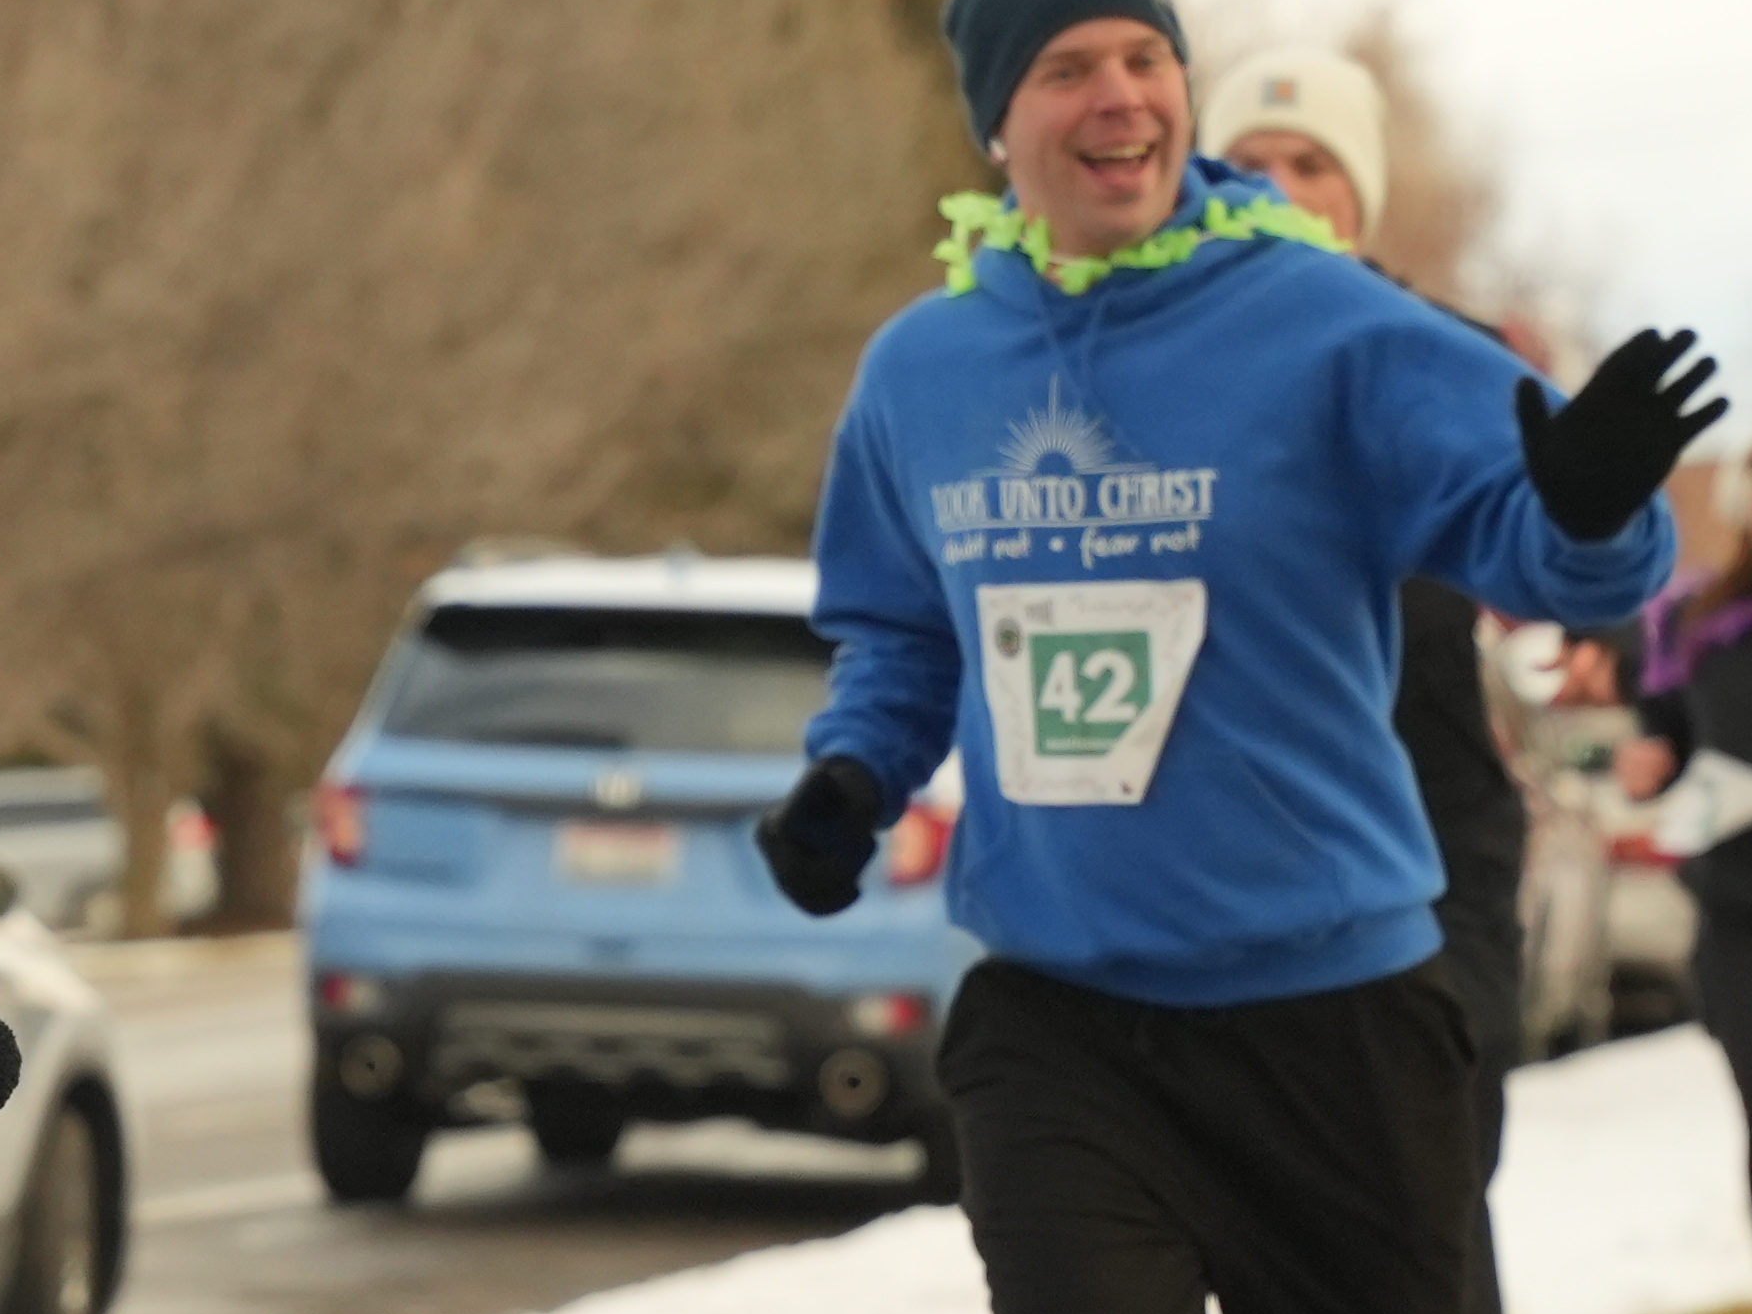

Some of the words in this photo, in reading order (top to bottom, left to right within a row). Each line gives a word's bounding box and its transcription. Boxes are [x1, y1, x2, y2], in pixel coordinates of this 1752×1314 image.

[999, 474, 1088, 522] UNTO
[1097, 467, 1219, 519] CHRIST
[1039, 648, 1138, 723] 42
